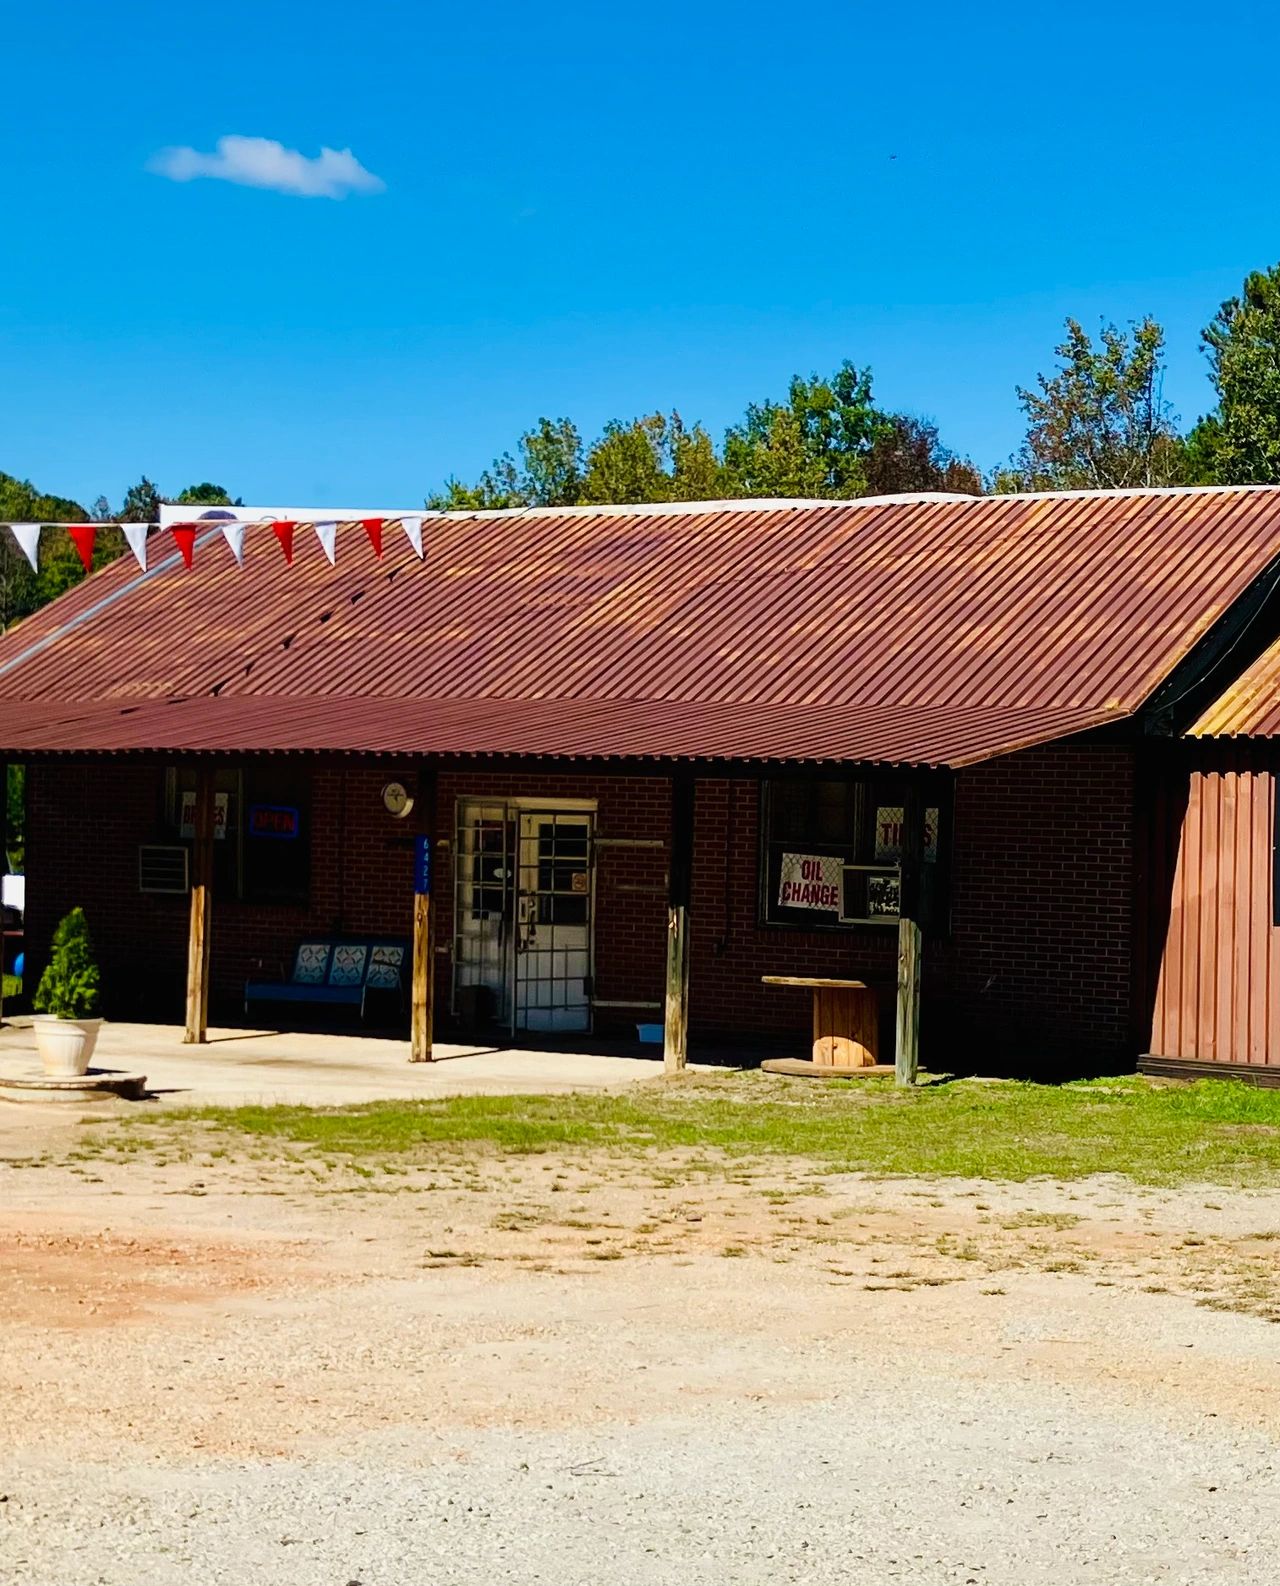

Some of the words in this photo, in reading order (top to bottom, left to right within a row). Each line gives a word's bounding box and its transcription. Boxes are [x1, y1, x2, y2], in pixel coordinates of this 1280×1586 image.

[253, 810, 295, 833] OPEN
[881, 823, 933, 847] TIS
[801, 860, 823, 882] OIL
[782, 881, 839, 906] CHANGE
